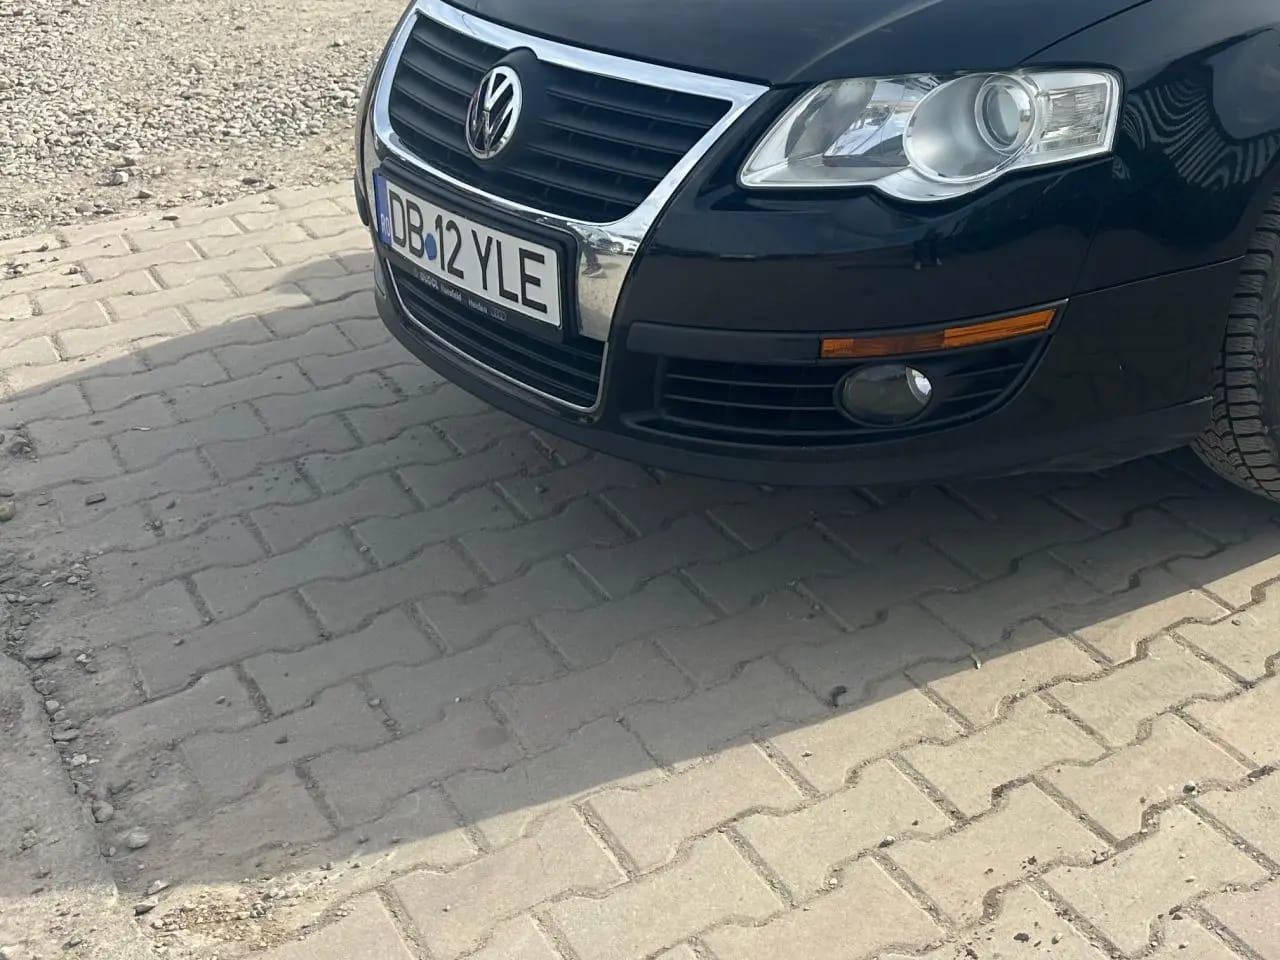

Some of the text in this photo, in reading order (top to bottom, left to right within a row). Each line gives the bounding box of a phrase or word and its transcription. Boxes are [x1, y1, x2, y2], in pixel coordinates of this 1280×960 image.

[388, 189, 425, 259] DB
[435, 214, 464, 280] 12
[471, 229, 548, 314] YLE
